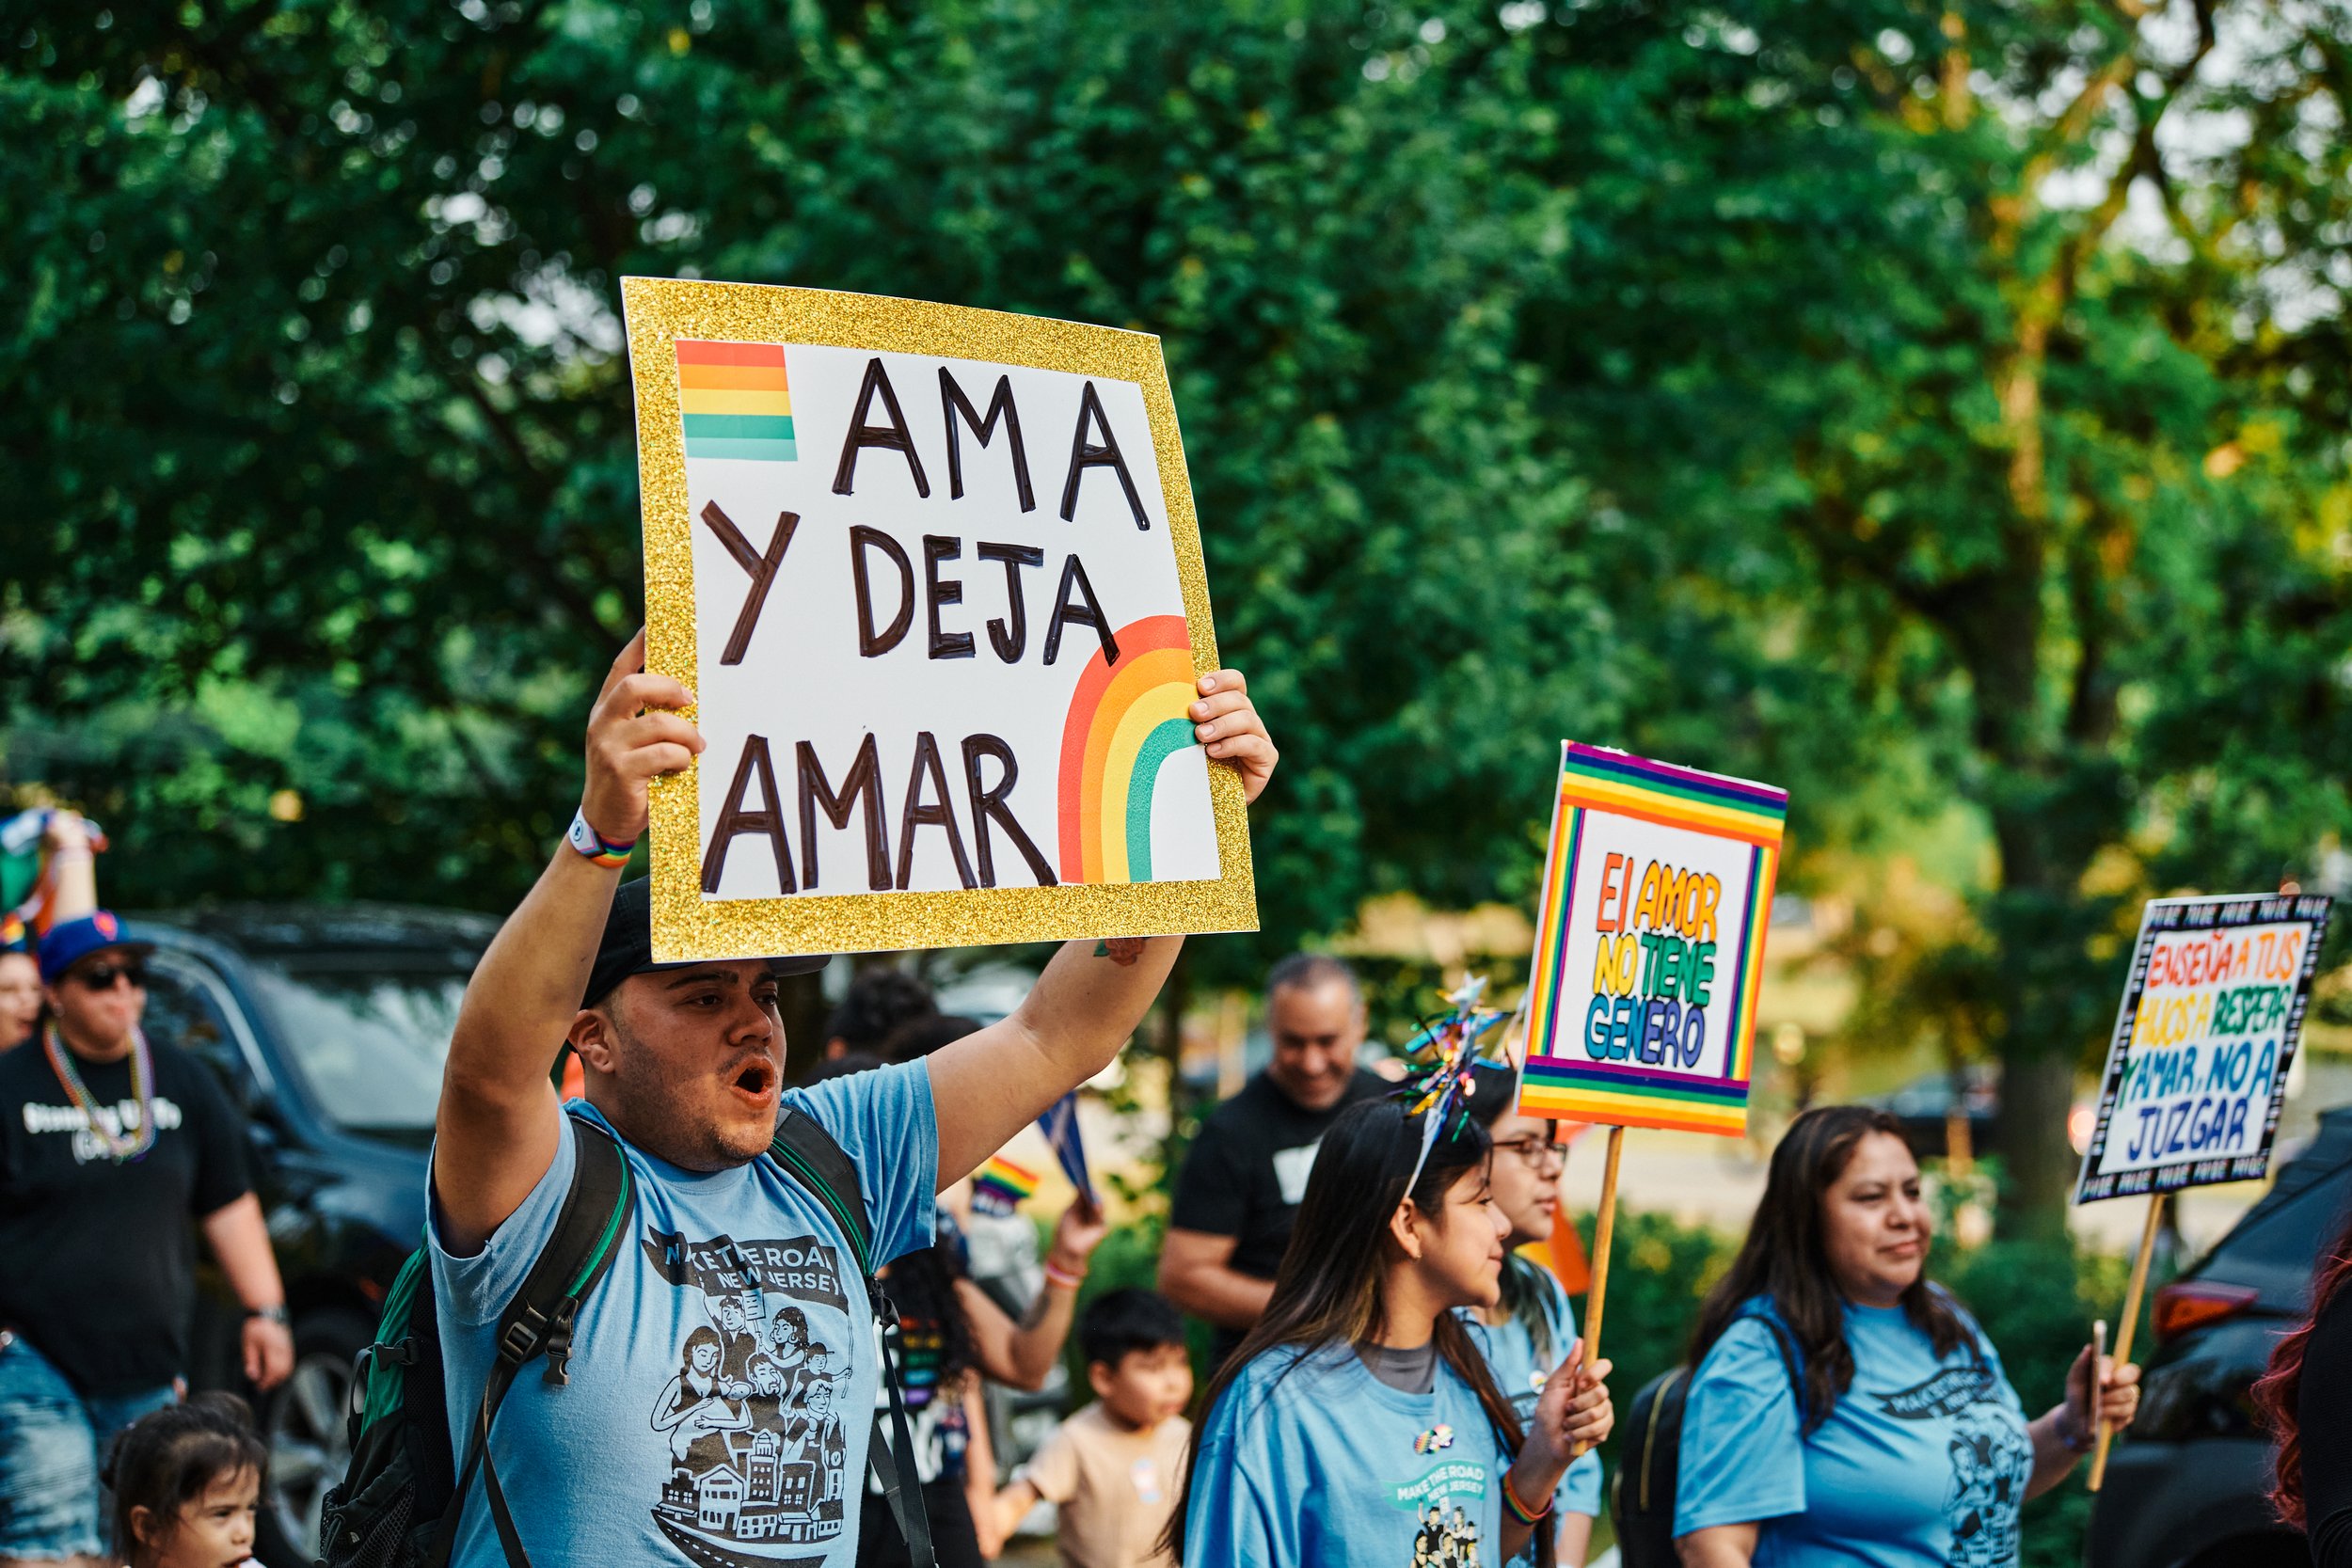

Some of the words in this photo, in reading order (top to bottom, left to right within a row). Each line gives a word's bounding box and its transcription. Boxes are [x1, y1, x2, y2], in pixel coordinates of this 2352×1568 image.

[832, 357, 1151, 531] AMA
[700, 499, 802, 665] Y
[849, 525, 1120, 667] DEJA
[700, 732, 1058, 895] AMAR
[1633, 859, 1722, 942] AMOR
[1593, 932, 1638, 996] NO
[1640, 931, 1717, 1008] TIENE
[2149, 927, 2233, 988] ENSEÑA
[2231, 937, 2250, 978] A
[2255, 929, 2301, 981] TUS
[1584, 992, 1706, 1069] GENERO
[2130, 992, 2196, 1047] HIJOS
[2189, 993, 2211, 1040] A
[2206, 1040, 2252, 1092] NO
[2247, 1038, 2276, 1099] A
[2128, 1097, 2249, 1162] JUZGAR
[665, 1243, 720, 1272] MKE
[717, 1266, 762, 1289] NEW
[1397, 1479, 1430, 1500] MAKE
[1428, 1466, 1449, 1486] THE
[1448, 1465, 1485, 1481] ROAD
[1427, 1483, 1448, 1503] NEW
[1449, 1480, 1484, 1495] JERSEY
